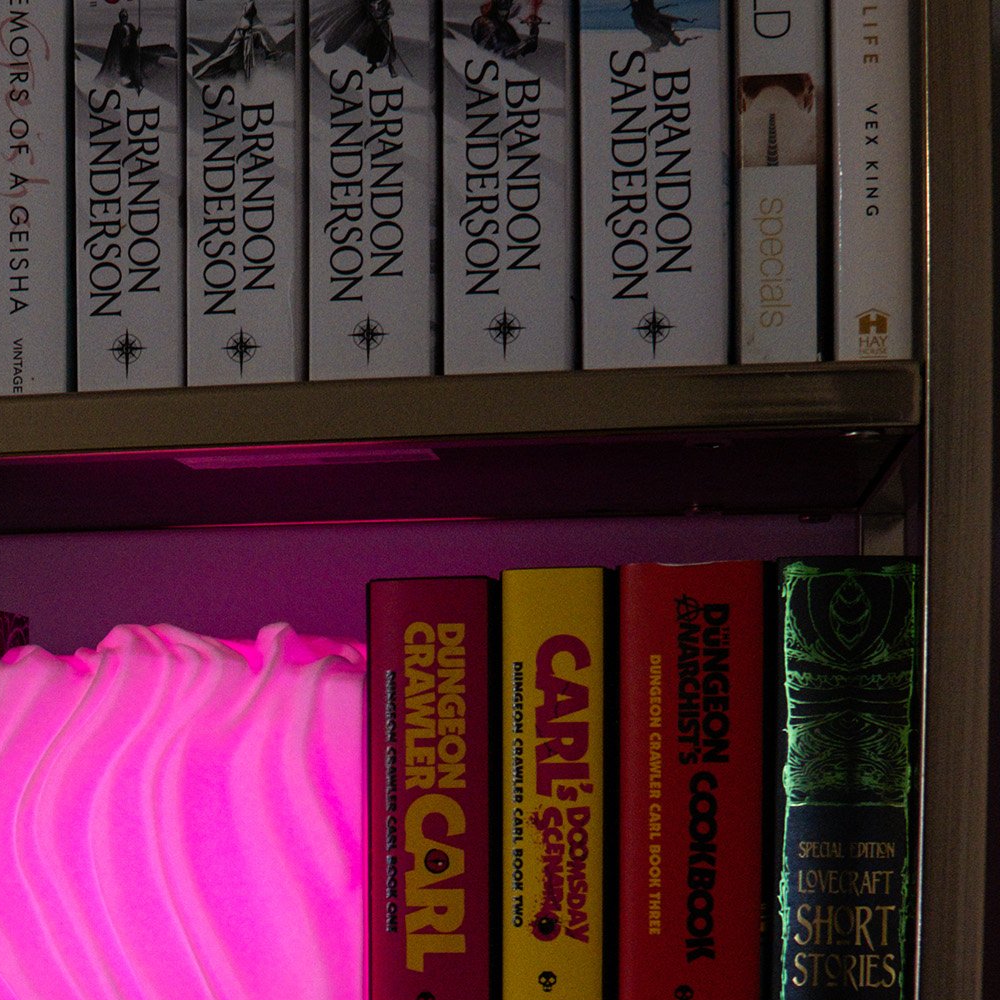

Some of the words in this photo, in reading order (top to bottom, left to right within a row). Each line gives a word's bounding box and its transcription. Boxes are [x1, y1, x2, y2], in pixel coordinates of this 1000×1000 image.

[862, 6, 879, 64] LIFE
[9, 119, 29, 154] OF
[864, 103, 879, 146] VEX
[9, 173, 29, 190] A
[84, 89, 122, 317] SANDERSON
[121, 106, 160, 292] BRANDON
[197, 85, 236, 315] SANDERSON
[236, 101, 275, 290] BRANDON
[324, 69, 363, 301] SANDERSON
[364, 86, 404, 277] BRANDON
[459, 59, 500, 295] SANDERSON
[500, 77, 541, 270] BRANDON
[605, 50, 648, 300] SANDERSON
[648, 68, 692, 273] BRANDON
[865, 161, 879, 217] KING
[9, 206, 29, 315] GEISHA
[753, 197, 792, 328] specials
[13, 338, 23, 393] VINTAGE
[859, 336, 888, 348] HAY
[404, 621, 436, 790] CRAWLER
[437, 623, 467, 789] DUNGEON
[512, 662, 523, 733] DUNGEON
[648, 654, 662, 728] DUNGEON
[702, 604, 730, 763] DUNGEON
[512, 738, 523, 804] CRAWLER
[648, 732, 662, 799] CRAWLER
[512, 808, 523, 843] CARL
[648, 803, 662, 839] CARL
[799, 841, 844, 859] SPECIAL
[850, 841, 895, 859] EDITION
[386, 855, 398, 898] BOOK
[404, 793, 467, 973] CARL
[512, 849, 523, 891] BOOK
[566, 806, 590, 943] DOOMSDAY
[648, 844, 662, 886] BOOK
[686, 772, 718, 963] COOKBOOK
[798, 870, 894, 896] LOVECRAFT
[386, 902, 398, 933] ONE
[512, 896, 523, 928] TWO
[648, 889, 662, 936] THREE
[794, 903, 896, 951] SHORT
[791, 952, 897, 991] STORIES
